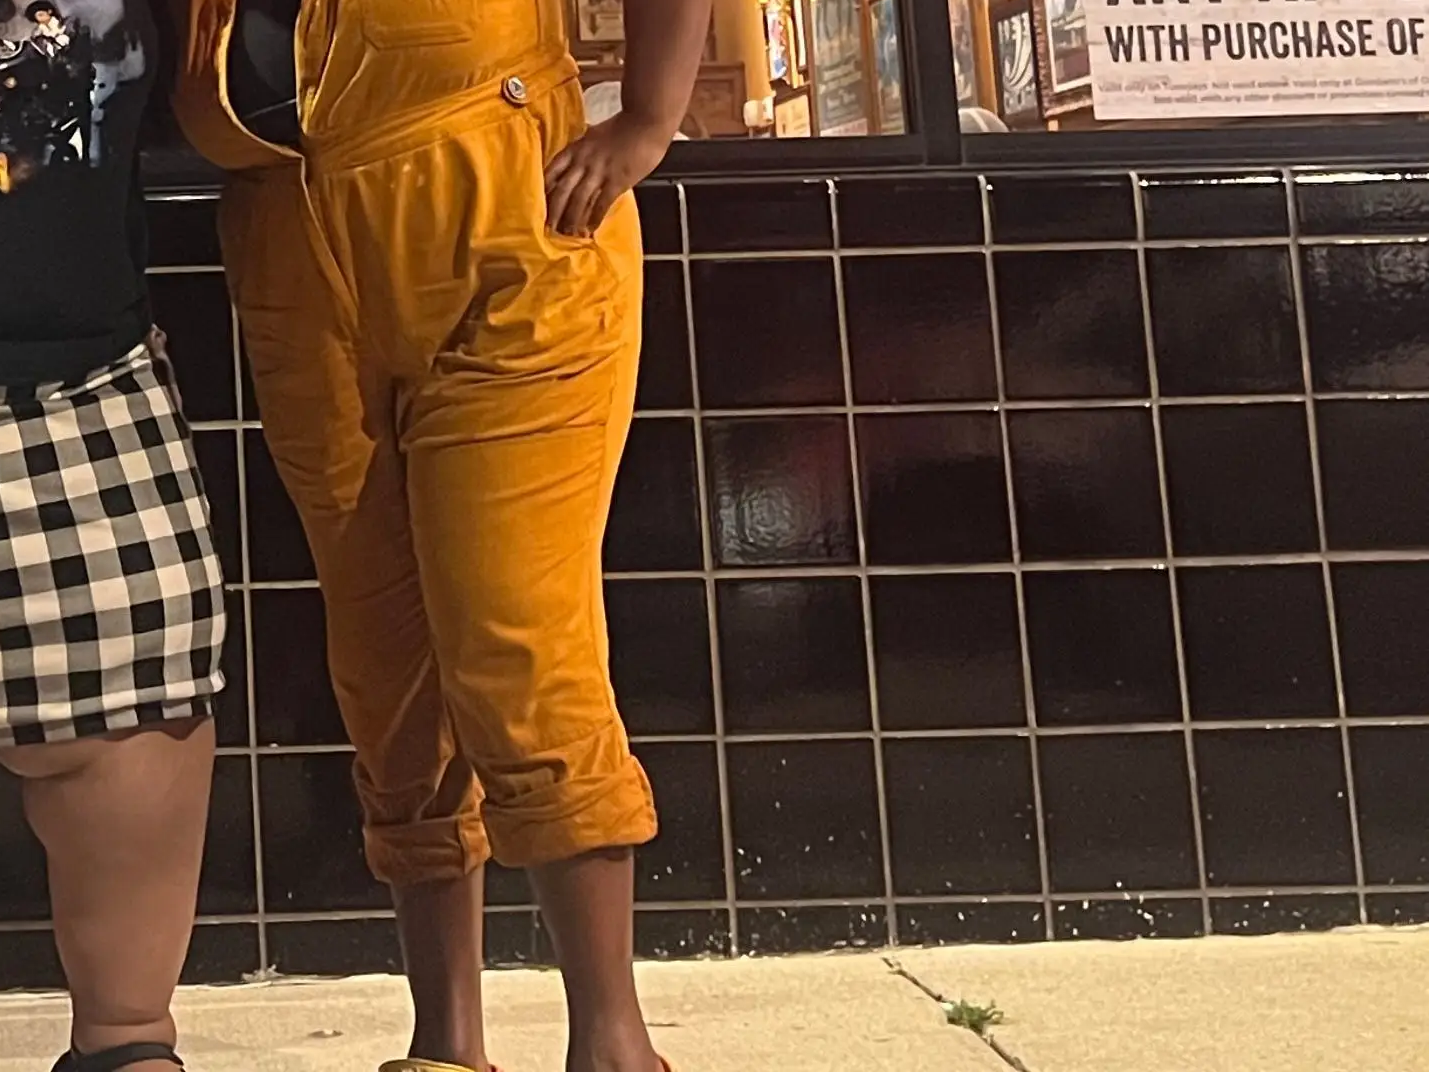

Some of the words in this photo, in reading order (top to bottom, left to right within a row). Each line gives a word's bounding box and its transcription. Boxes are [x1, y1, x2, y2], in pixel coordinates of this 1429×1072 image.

[1104, 24, 1190, 63] WITH
[1203, 19, 1377, 61] PURCHASE
[1387, 18, 1425, 55] OF
